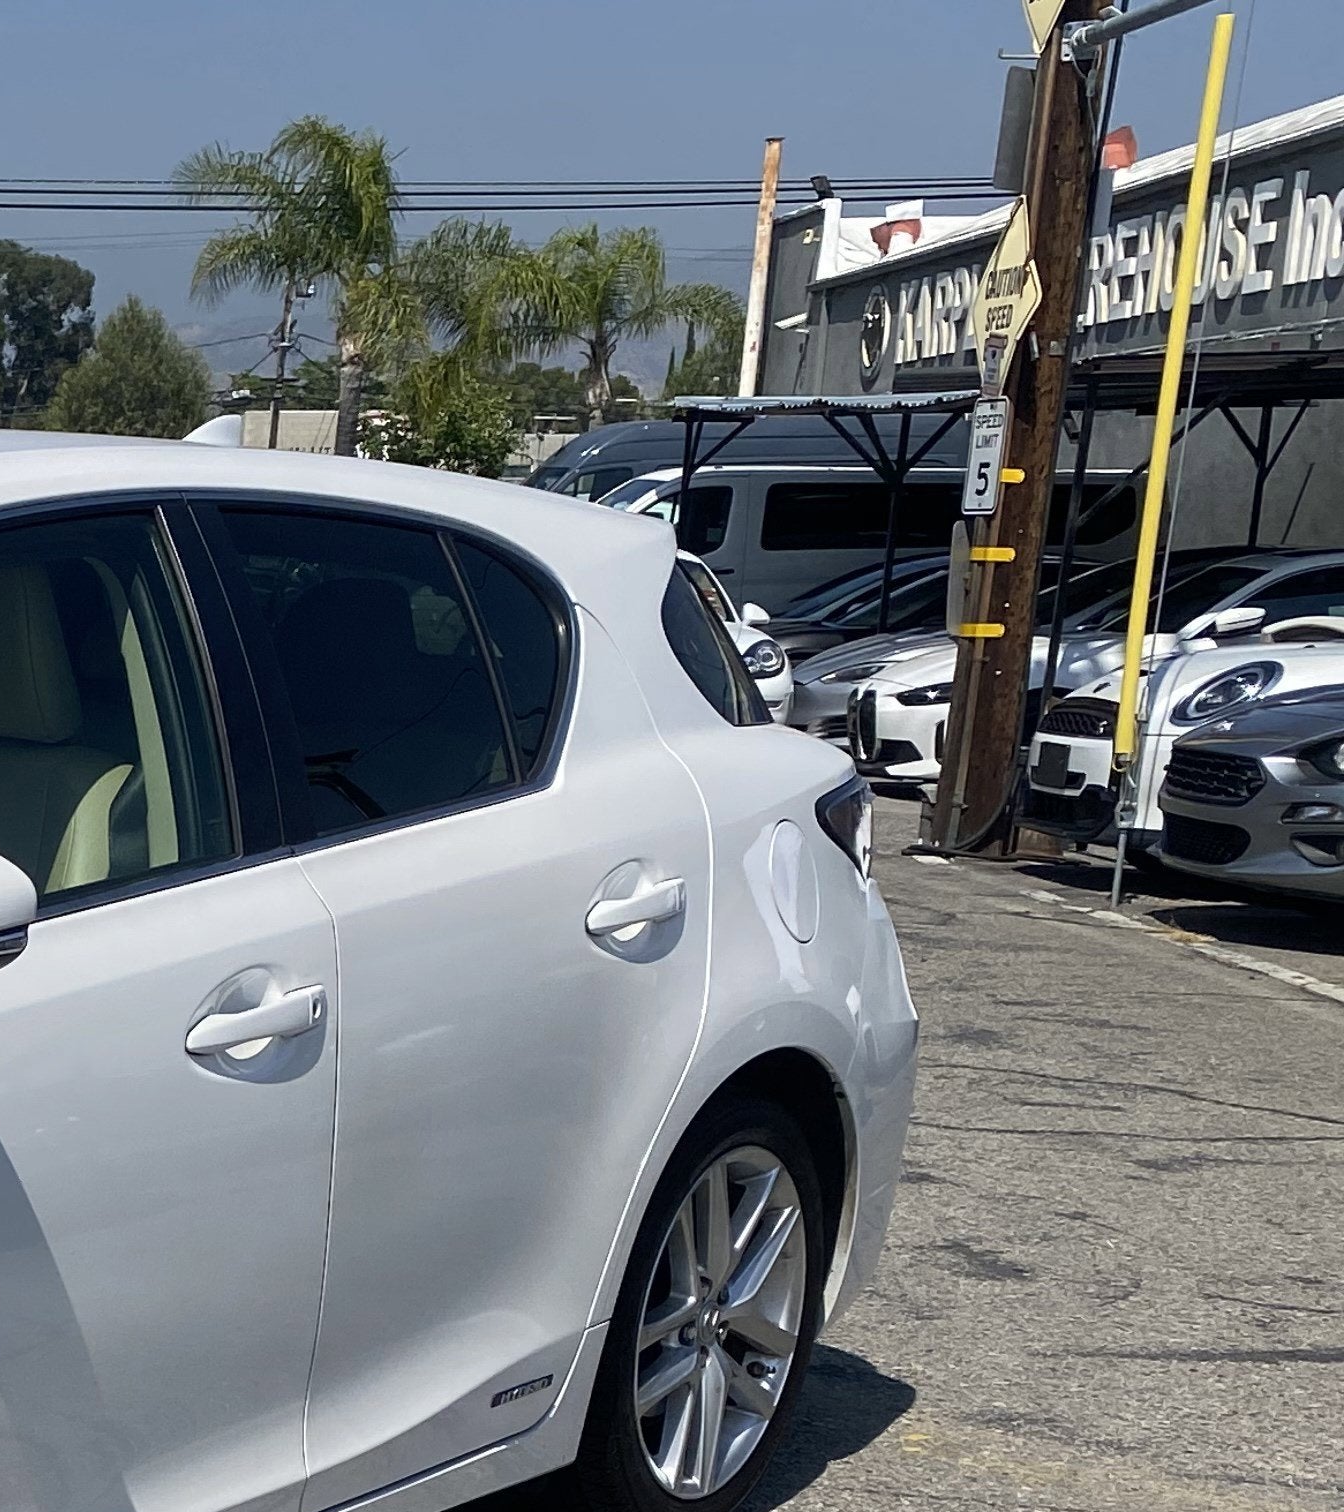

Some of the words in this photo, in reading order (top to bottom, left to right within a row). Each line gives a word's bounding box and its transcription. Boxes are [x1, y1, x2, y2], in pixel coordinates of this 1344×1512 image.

[985, 303, 1014, 332] SPEED
[975, 413, 1004, 430] SPEED
[975, 433, 1000, 449] LIMIT
[975, 462, 992, 496] 5
